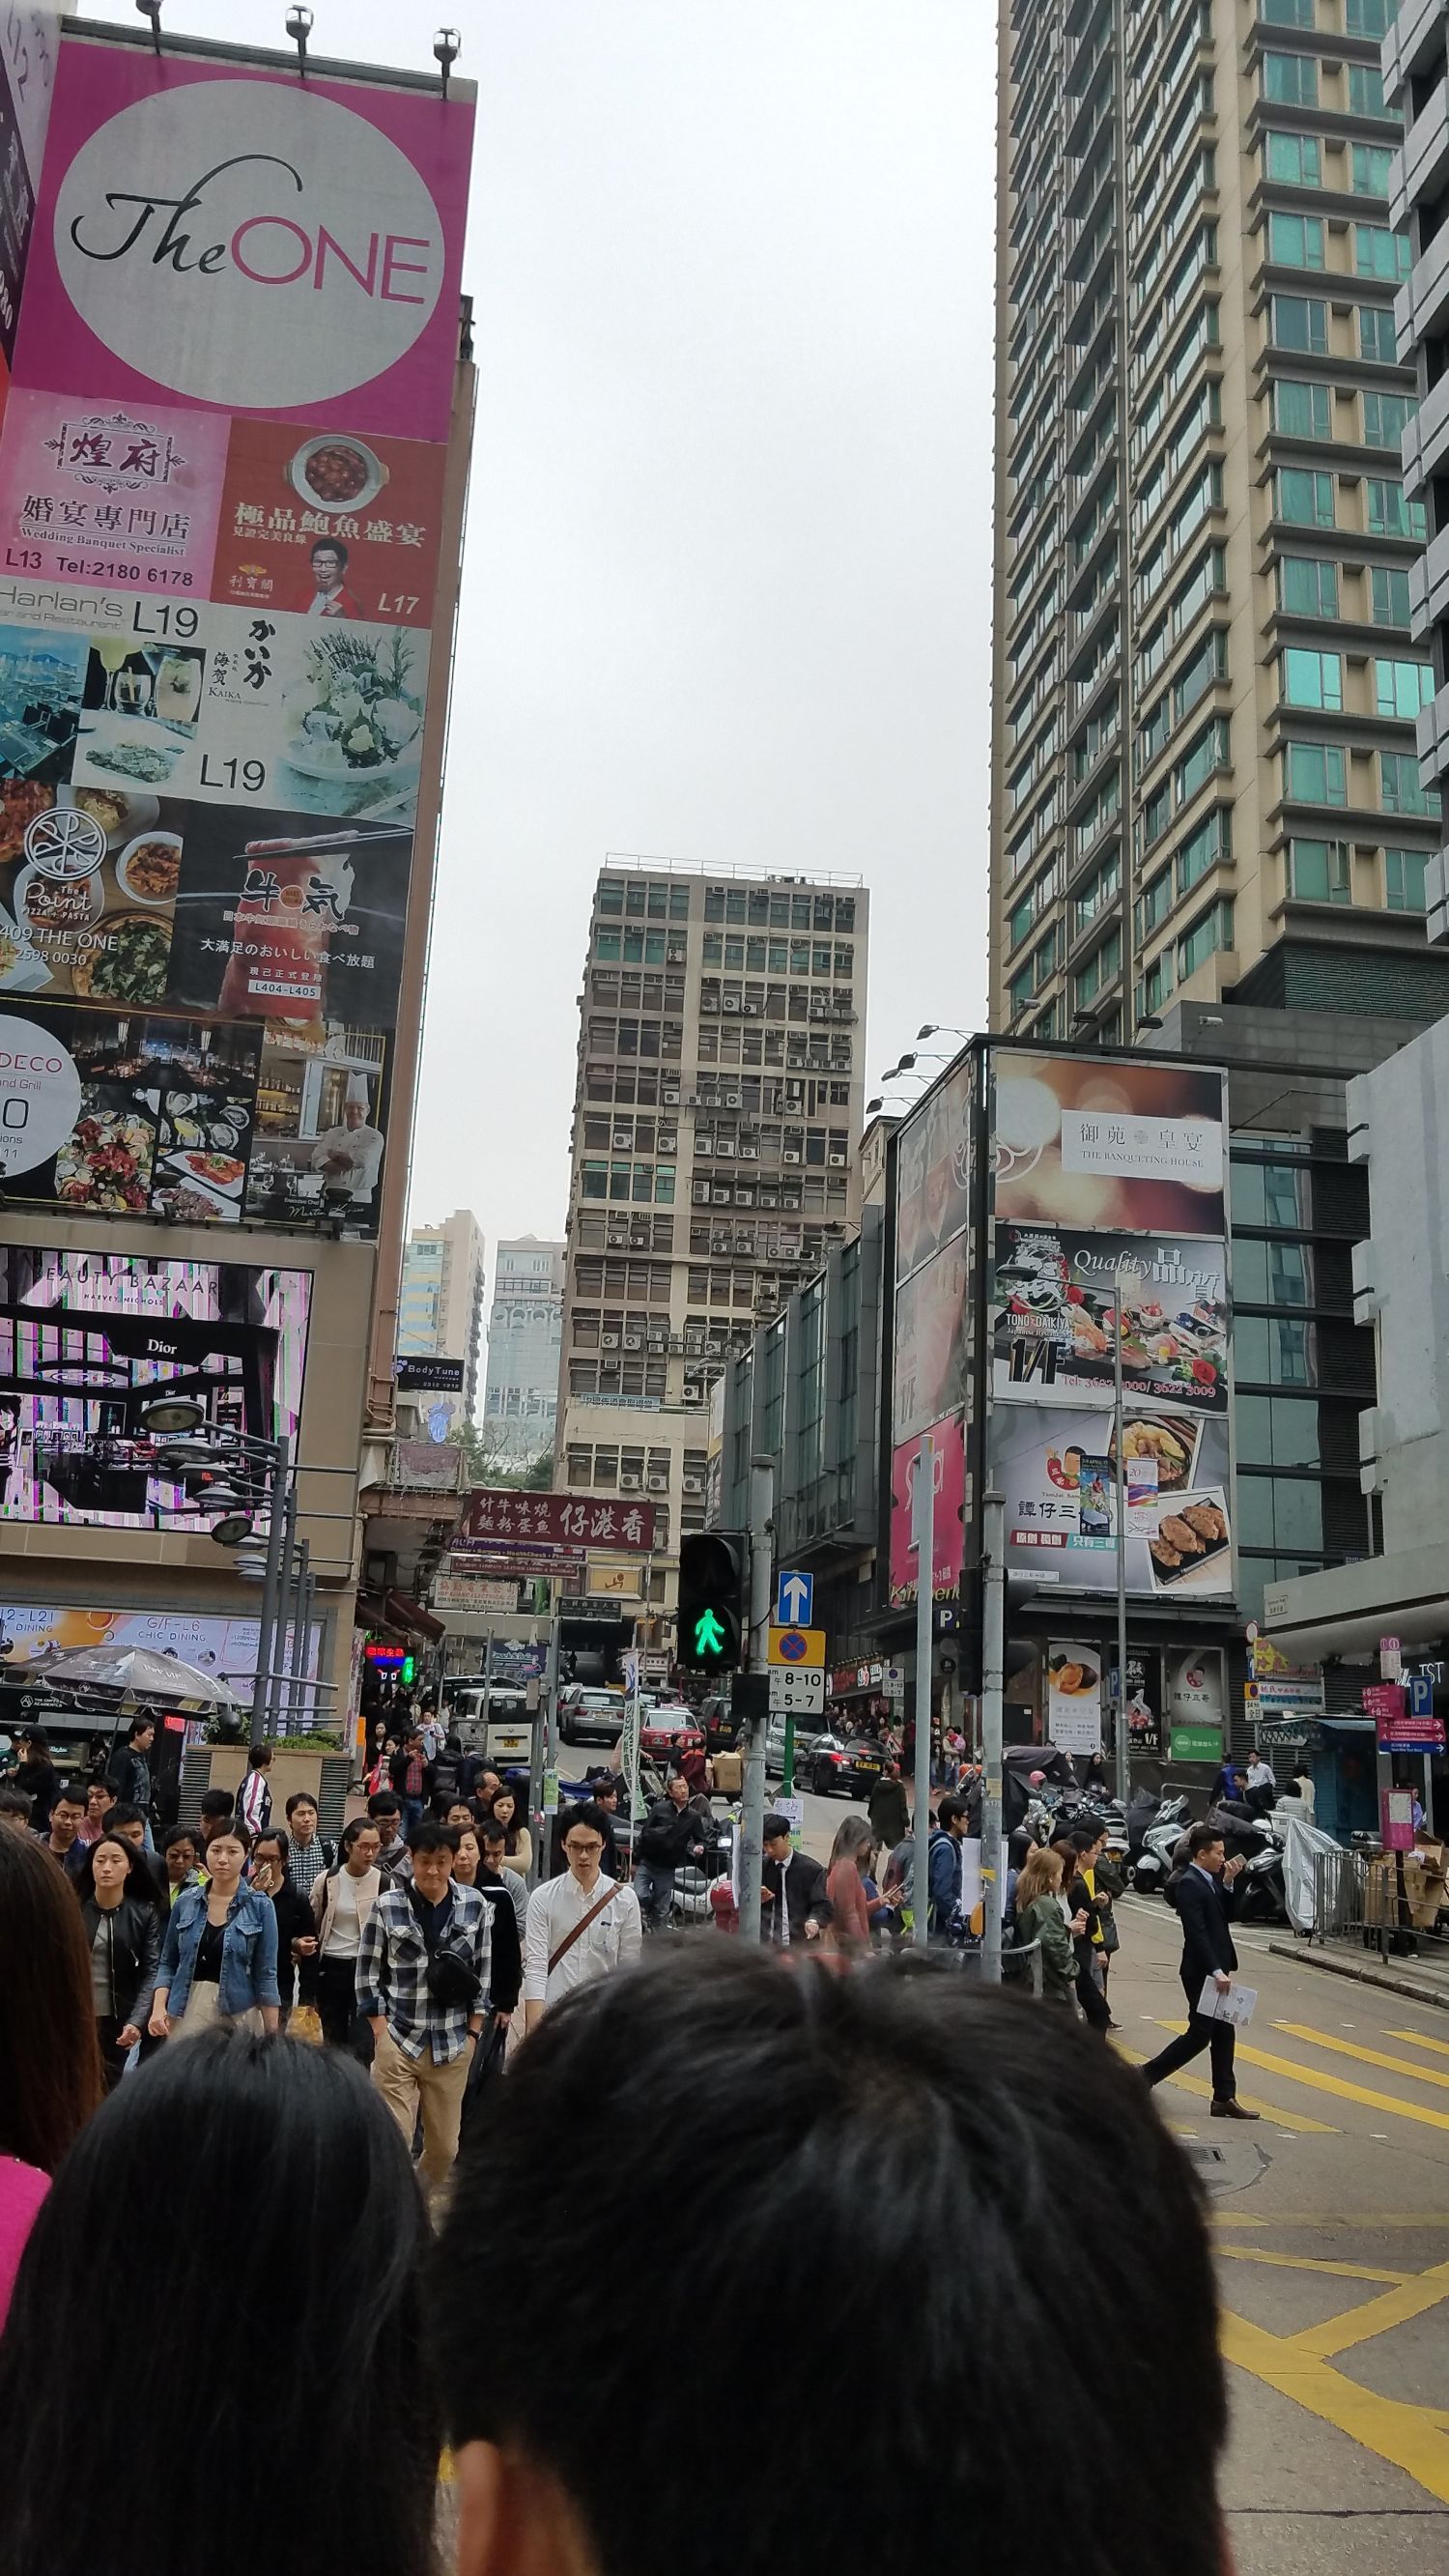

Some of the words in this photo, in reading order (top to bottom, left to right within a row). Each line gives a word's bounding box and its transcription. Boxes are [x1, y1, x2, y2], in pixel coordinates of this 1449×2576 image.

[71, 155, 237, 274] The
[232, 215, 431, 304] ONE
[71, 433, 161, 477] 煌府
[23, 495, 191, 539] 婚宴專門店
[235, 502, 426, 548] 極品鮑魚盛宴
[21, 528, 74, 544] Wedding
[77, 534, 127, 550] Banquet
[129, 541, 185, 556] Specialist
[6, 548, 43, 569] L13
[148, 568, 194, 587] 6178
[378, 593, 419, 615] L17
[43, 613, 122, 630] Restaurant
[132, 601, 199, 639] L19
[243, 619, 276, 690] かいか
[200, 754, 266, 792] L19
[23, 881, 94, 913] Point
[61, 885, 80, 896] The
[21, 907, 47, 918] PIZZA
[62, 912, 91, 922] PASTA
[37, 928, 74, 947] THE
[77, 933, 119, 952] ONE
[15, 949, 49, 963] 2598
[52, 952, 88, 966] 0030
[255, 982, 317, 997] L404-L405
[20, 1079, 42, 1090] Grill
[1081, 1150, 1102, 1159] THE
[1104, 1153, 1168, 1164] BANQUETING
[1170, 1158, 1204, 1168] HOUSE
[1074, 1249, 1152, 1280] Quality
[130, 1274, 218, 1295] BAZAAR
[1153, 1247, 1221, 1304] 品質
[84, 1293, 118, 1302] HARVEY
[124, 1297, 163, 1305] NICHOLS
[147, 1339, 178, 1355] Dior
[1009, 1337, 1066, 1385] 1/F
[1062, 1374, 1081, 1387] Tel:
[1153, 1382, 1183, 1394] 3622
[1018, 1501, 1080, 1519] 譚仔三
[16, 1623, 53, 1633] DINING
[147, 1617, 201, 1632] G/F-L6
[940, 1610, 953, 1628] P
[138, 1631, 164, 1640] CHIC
[169, 1632, 207, 1642] DINING
[784, 1672, 821, 1687] 8-10
[1413, 1679, 1429, 1713] P
